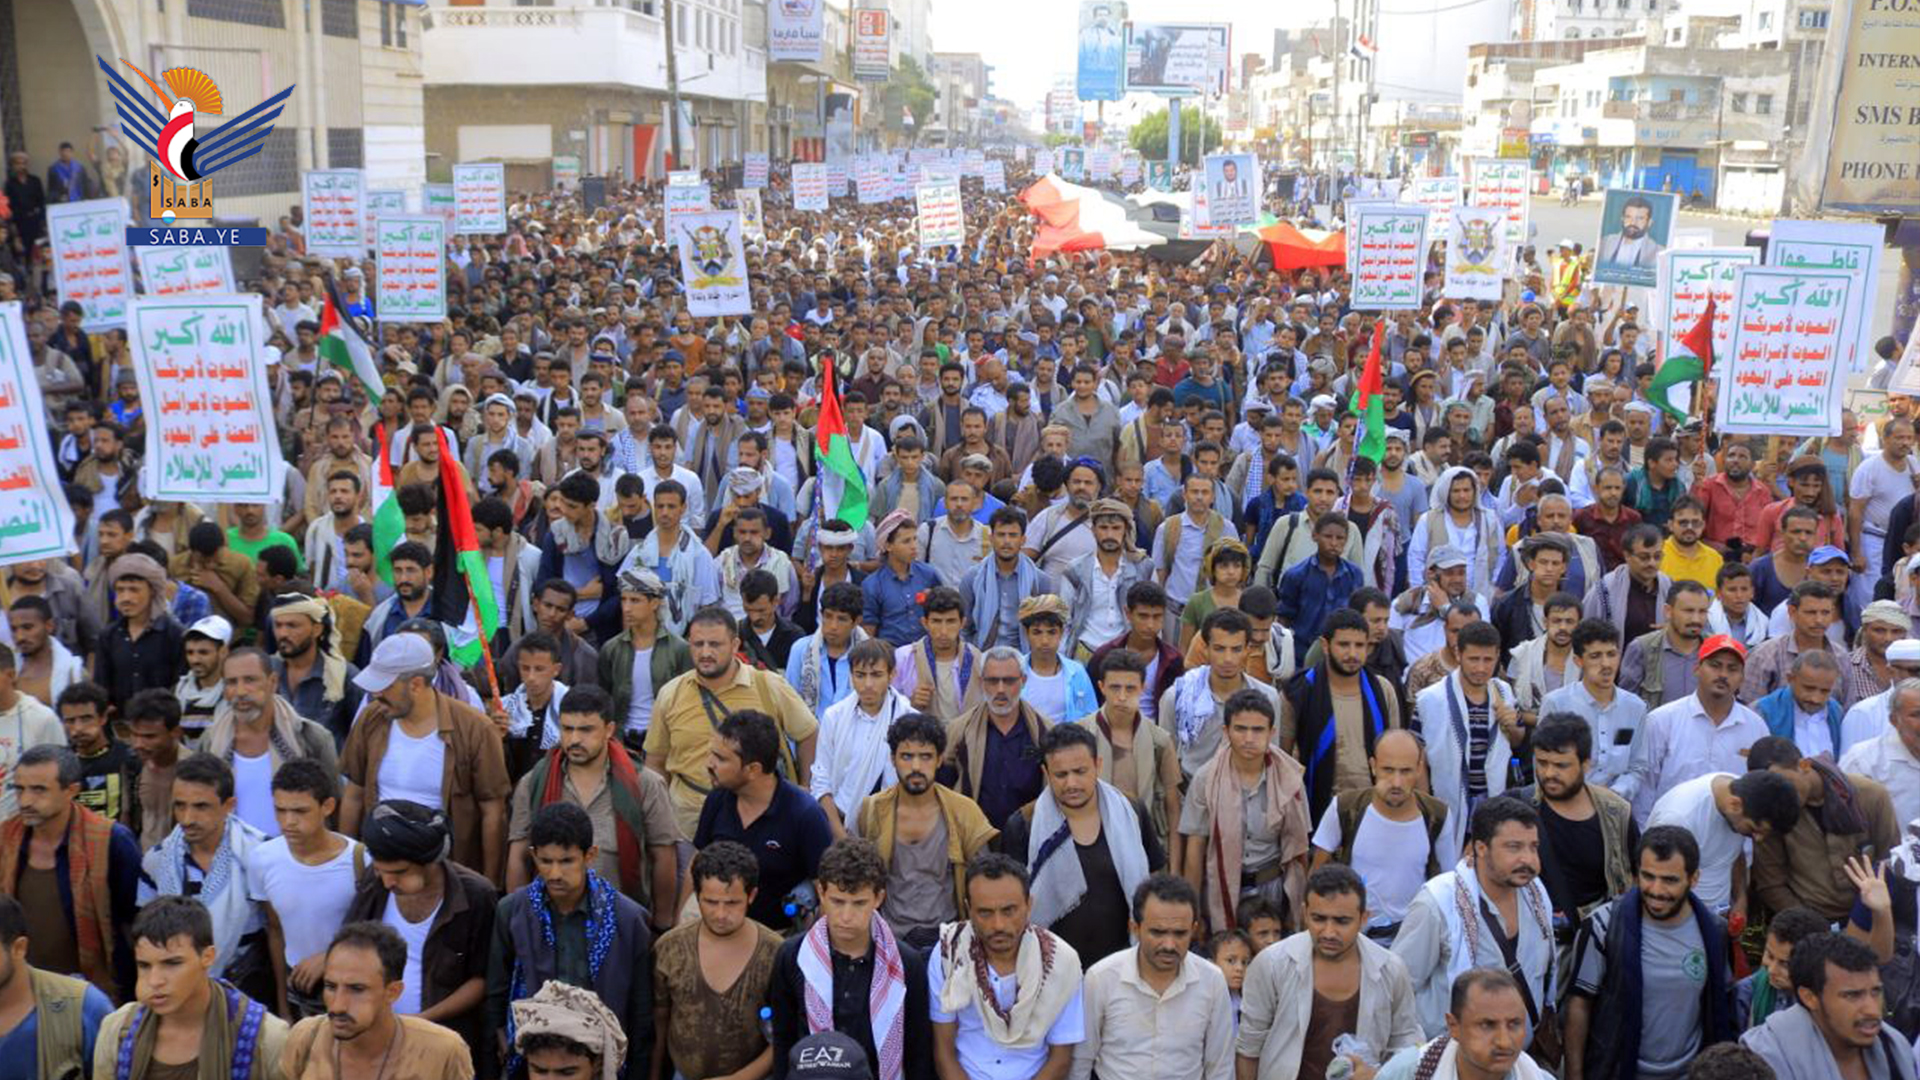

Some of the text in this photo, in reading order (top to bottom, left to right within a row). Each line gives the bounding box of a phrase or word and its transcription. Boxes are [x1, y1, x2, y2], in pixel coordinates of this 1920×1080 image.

[1855, 106, 1902, 125] SMS
[1840, 161, 1909, 180] PHONE
[1364, 215, 1420, 237] الله أكبر
[1675, 260, 1720, 286] أكبر
[1746, 276, 1842, 312] الله أكبر
[149, 310, 205, 354] أكبر
[210, 315, 245, 345] الله
[1743, 311, 1837, 337] الموت لأمريكا
[1739, 342, 1790, 363] لإسرائيل
[1792, 345, 1832, 363] الموت
[153, 354, 249, 383] الموت لأمريكا
[1736, 370, 1828, 389] اللعنة على اليهود
[160, 390, 255, 417] الموت لإسرائيل
[1733, 391, 1824, 422] النصر للإسلام
[163, 423, 261, 449] اللعنة على اليهود
[166, 450, 264, 489] النصر للإسلام
[799, 1046, 844, 1063] EA7
